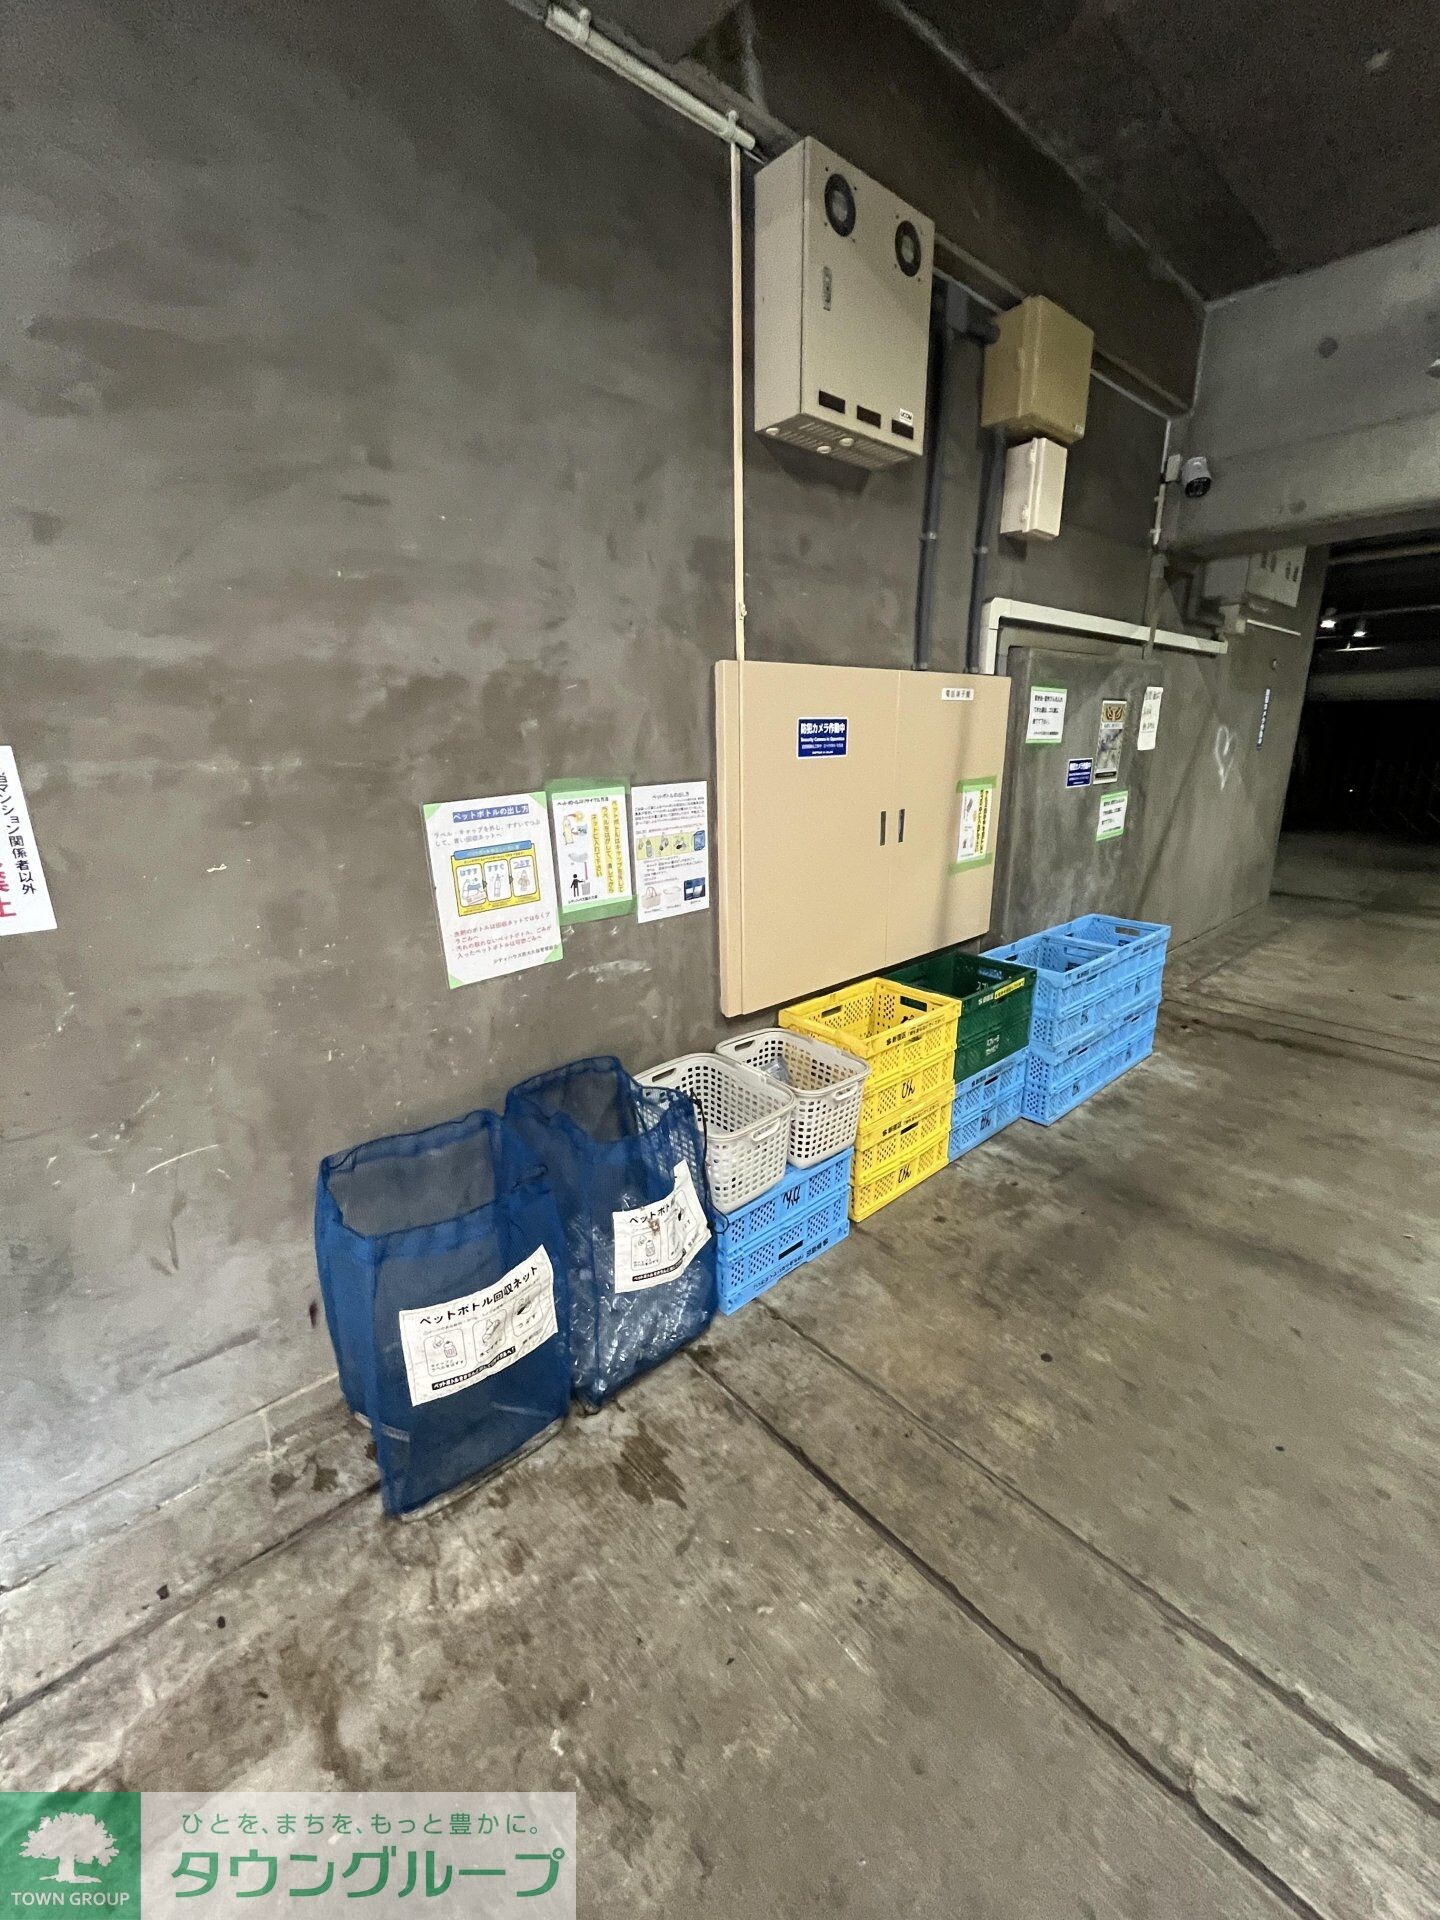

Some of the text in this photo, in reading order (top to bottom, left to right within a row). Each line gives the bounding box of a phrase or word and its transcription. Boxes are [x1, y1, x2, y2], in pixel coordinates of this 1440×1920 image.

[800, 722, 846, 734] 防犯カメラ作動中
[453, 806, 529, 822] ペットボトルの出し方
[420, 1266, 538, 1324] ペットボトル回収ネット
